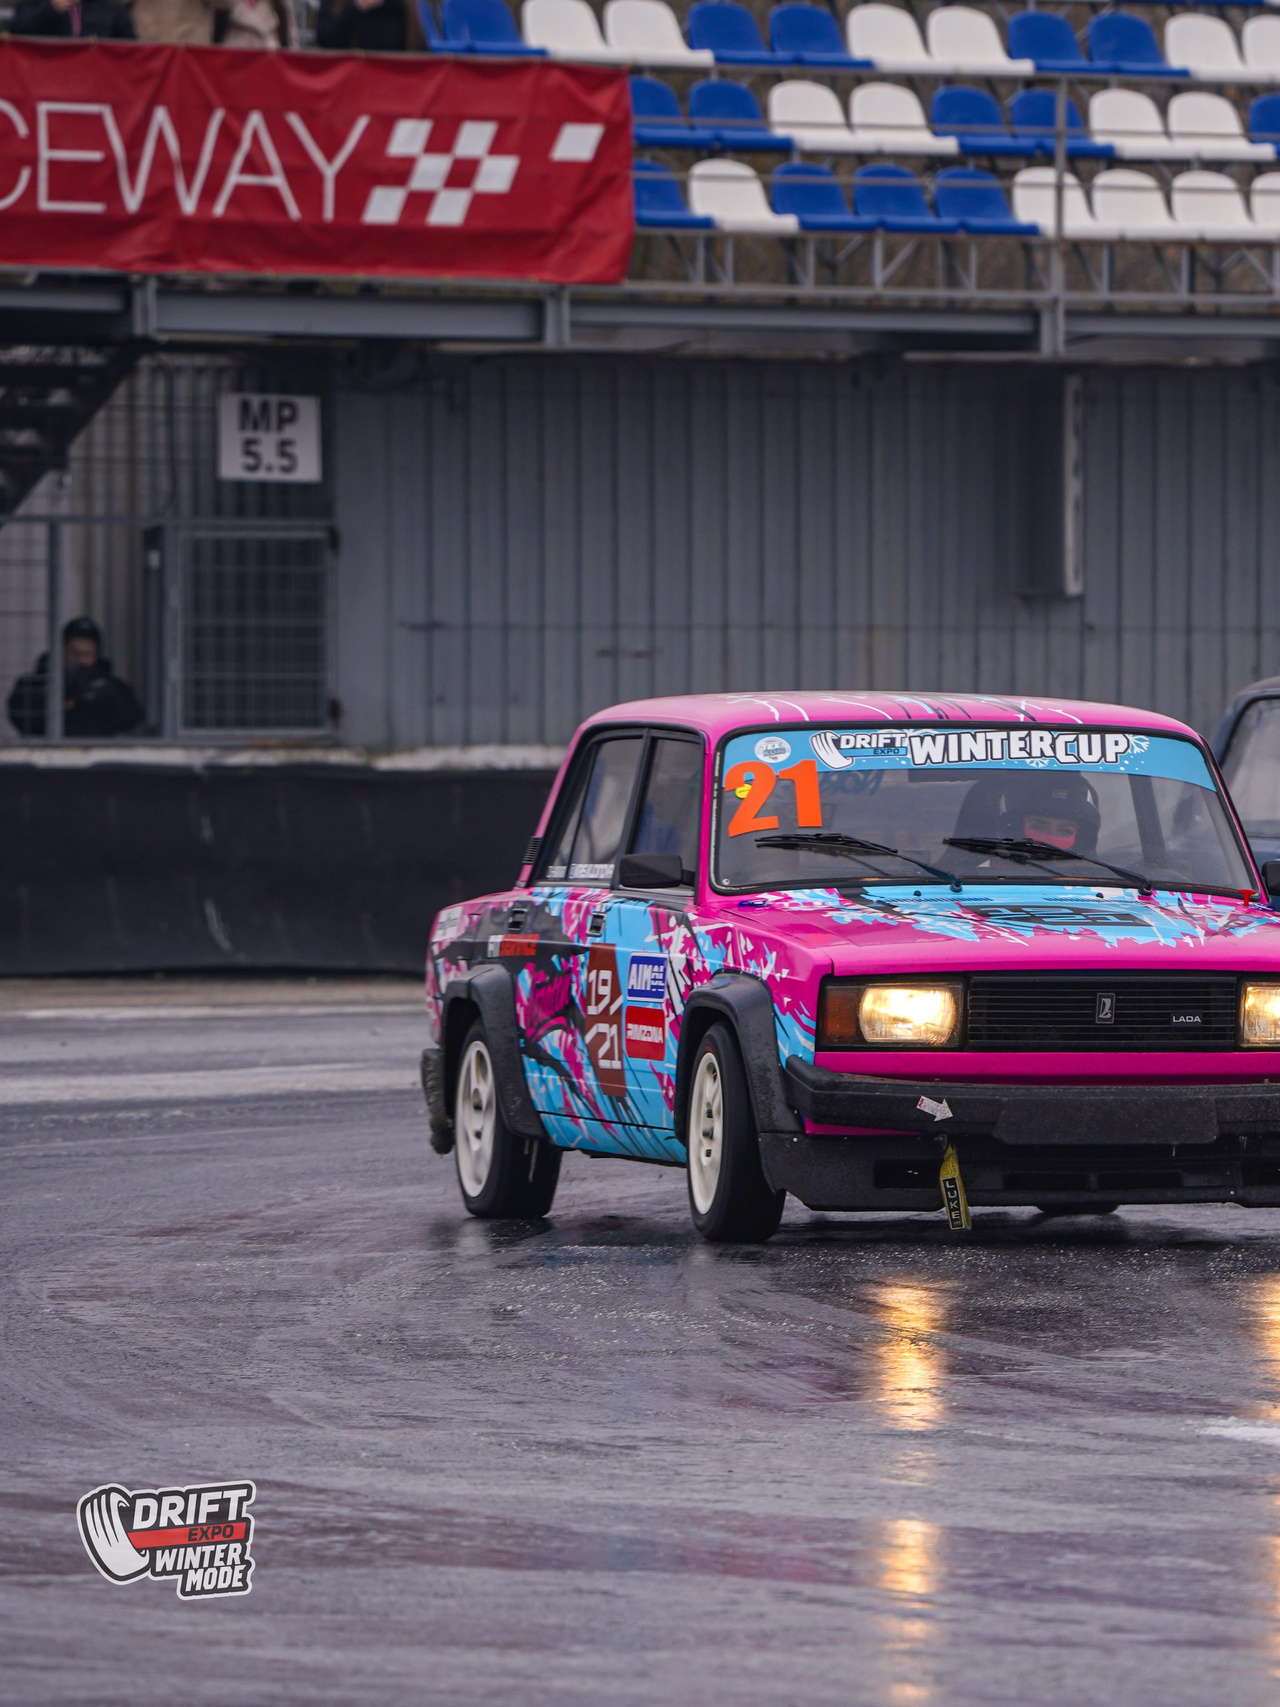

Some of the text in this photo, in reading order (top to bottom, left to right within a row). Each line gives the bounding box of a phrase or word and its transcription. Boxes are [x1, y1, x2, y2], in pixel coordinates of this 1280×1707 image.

[239, 399, 298, 432] MP
[242, 438, 299, 474] 5.5
[840, 733, 906, 749] DRIFT
[873, 747, 900, 755] EXPO
[724, 759, 823, 838] 21
[1172, 1015, 1202, 1023] LADA
[945, 1180, 961, 1219] LUKE
